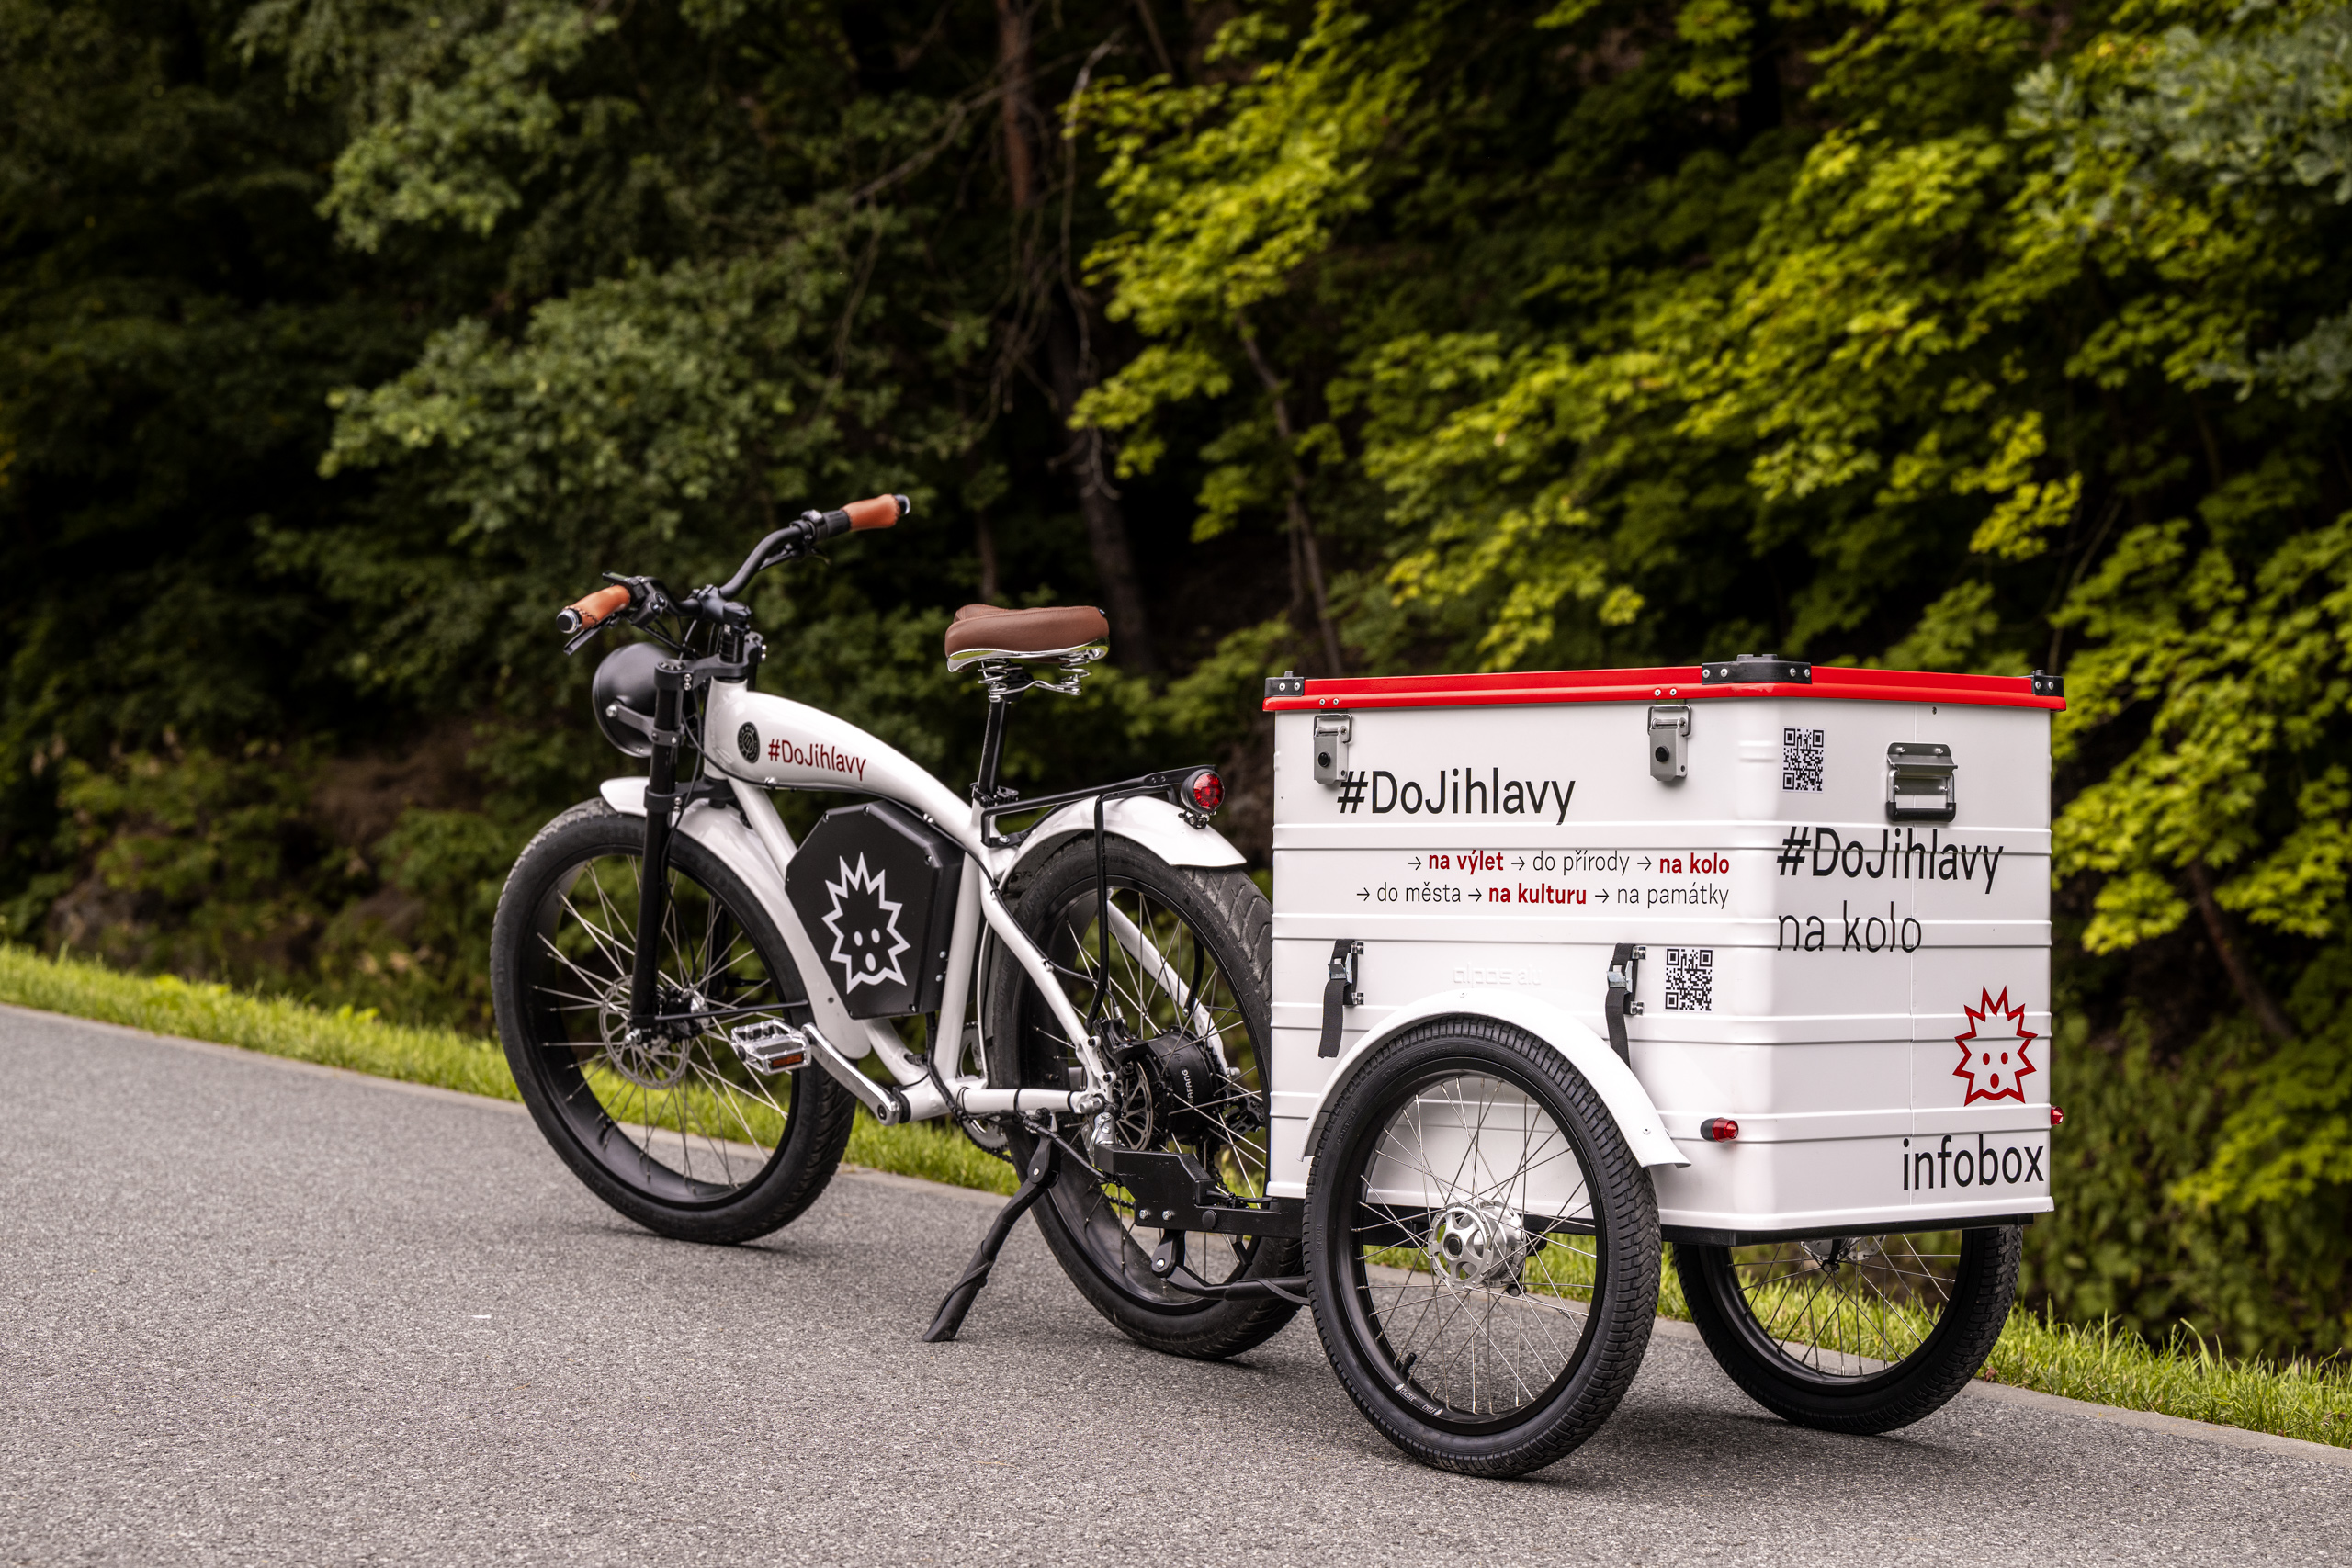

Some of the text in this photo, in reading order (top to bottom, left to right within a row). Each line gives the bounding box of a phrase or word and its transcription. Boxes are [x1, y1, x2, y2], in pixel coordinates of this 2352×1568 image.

[768, 739, 866, 781] #DoJihlavy
[1338, 768, 1576, 826] #DoJihlavy
[1429, 850, 1504, 875] na výlet
[1532, 850, 1630, 876] do přírody
[1659, 852, 1730, 874] na kolo
[1777, 826, 2004, 895] #DoJihlavy
[1377, 882, 1461, 903] do města
[1488, 882, 1587, 905] na kulturu
[1617, 881, 1729, 910] na památky
[1777, 900, 1922, 953] na kolo
[1903, 1134, 2044, 1191] infobox
